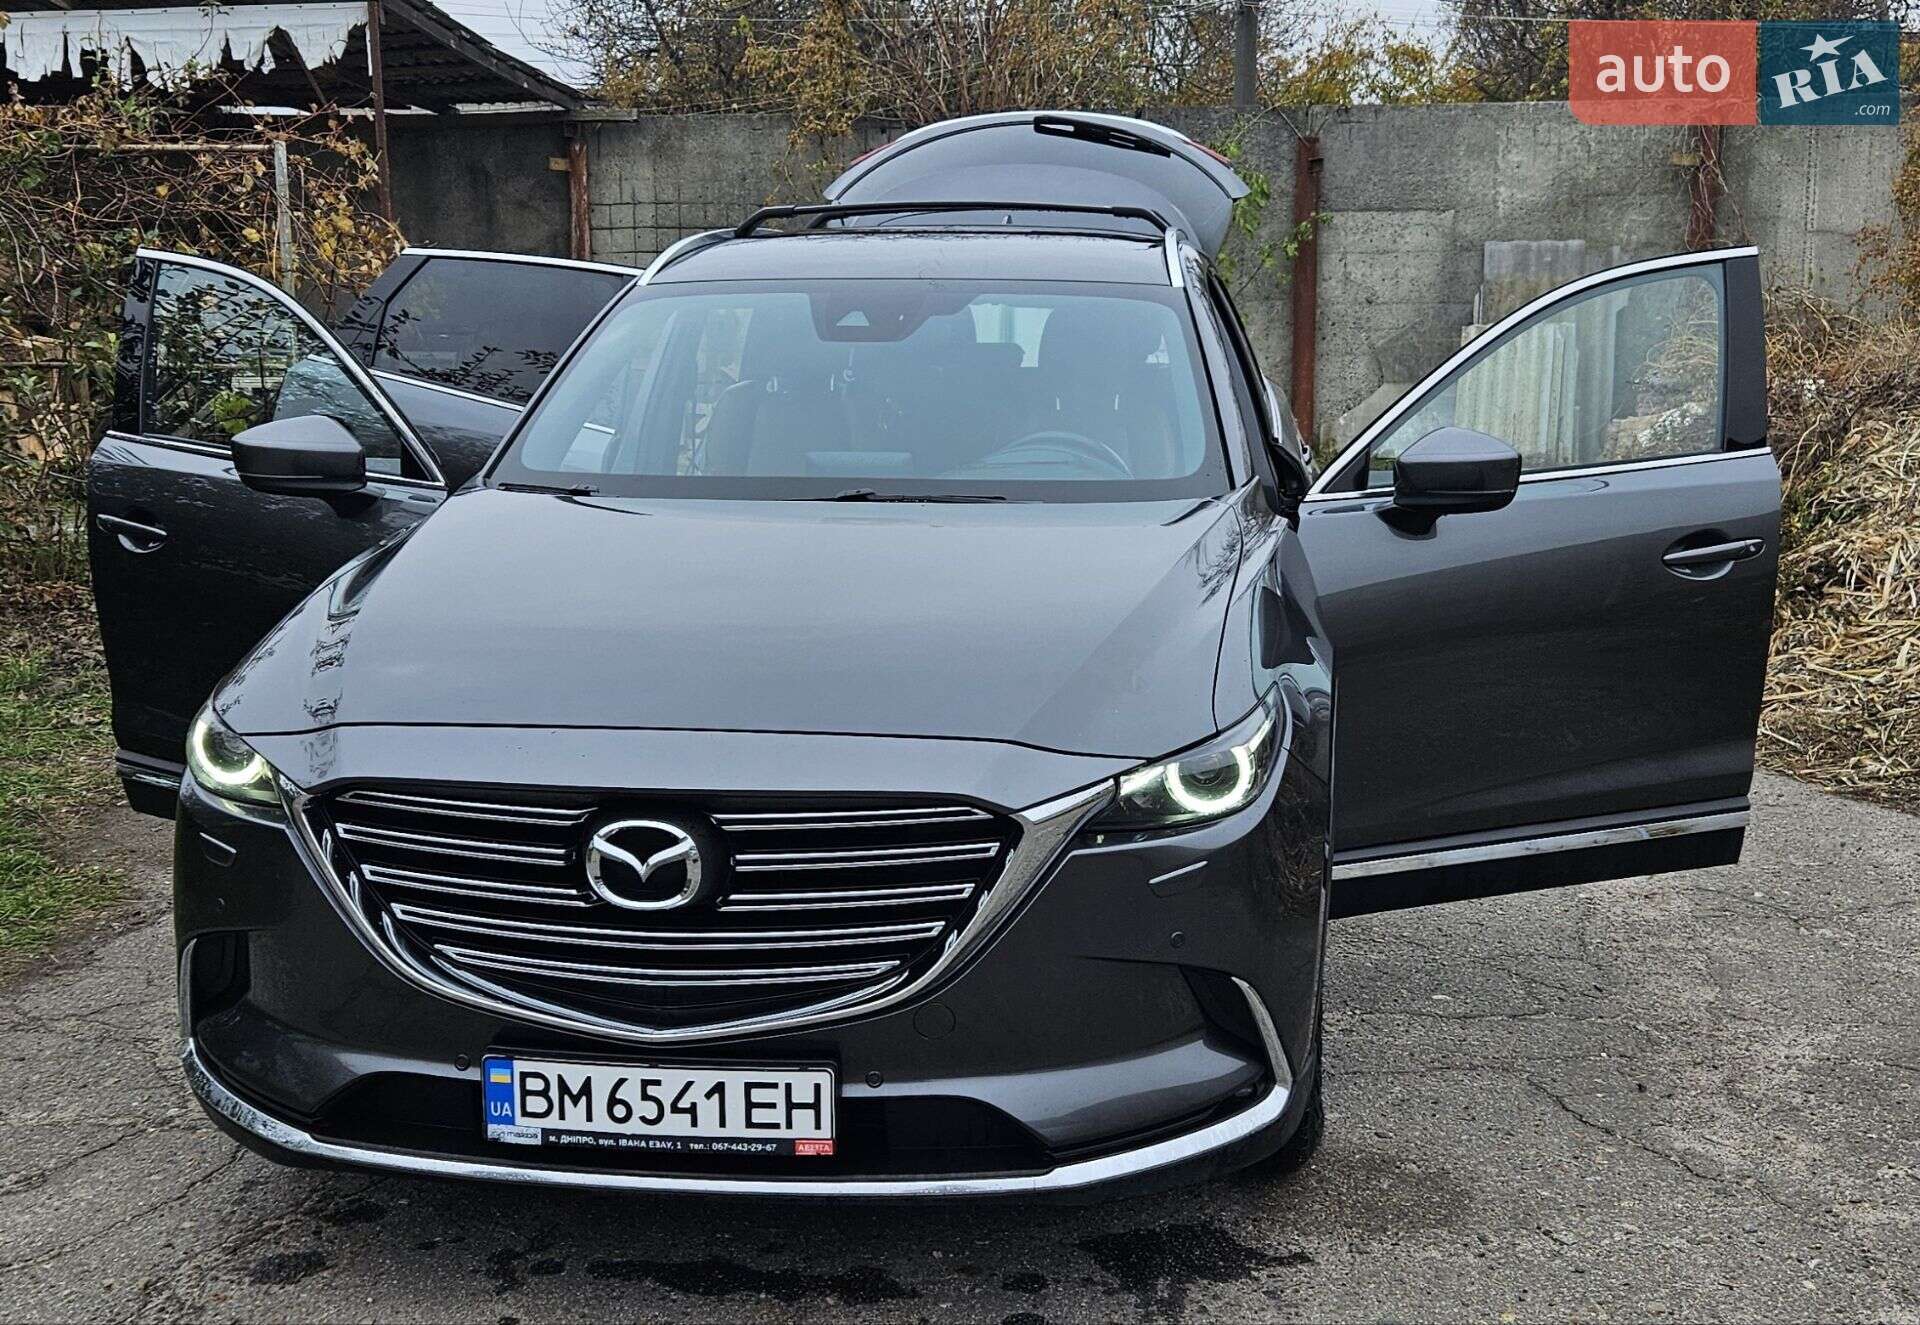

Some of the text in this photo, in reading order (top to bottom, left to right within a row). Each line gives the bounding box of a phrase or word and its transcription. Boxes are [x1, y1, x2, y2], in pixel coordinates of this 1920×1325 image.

[519, 1070, 823, 1131] BM 6541 EH
[490, 1101, 513, 1117] UA
[711, 1142, 777, 1152] 067-443-29-67
